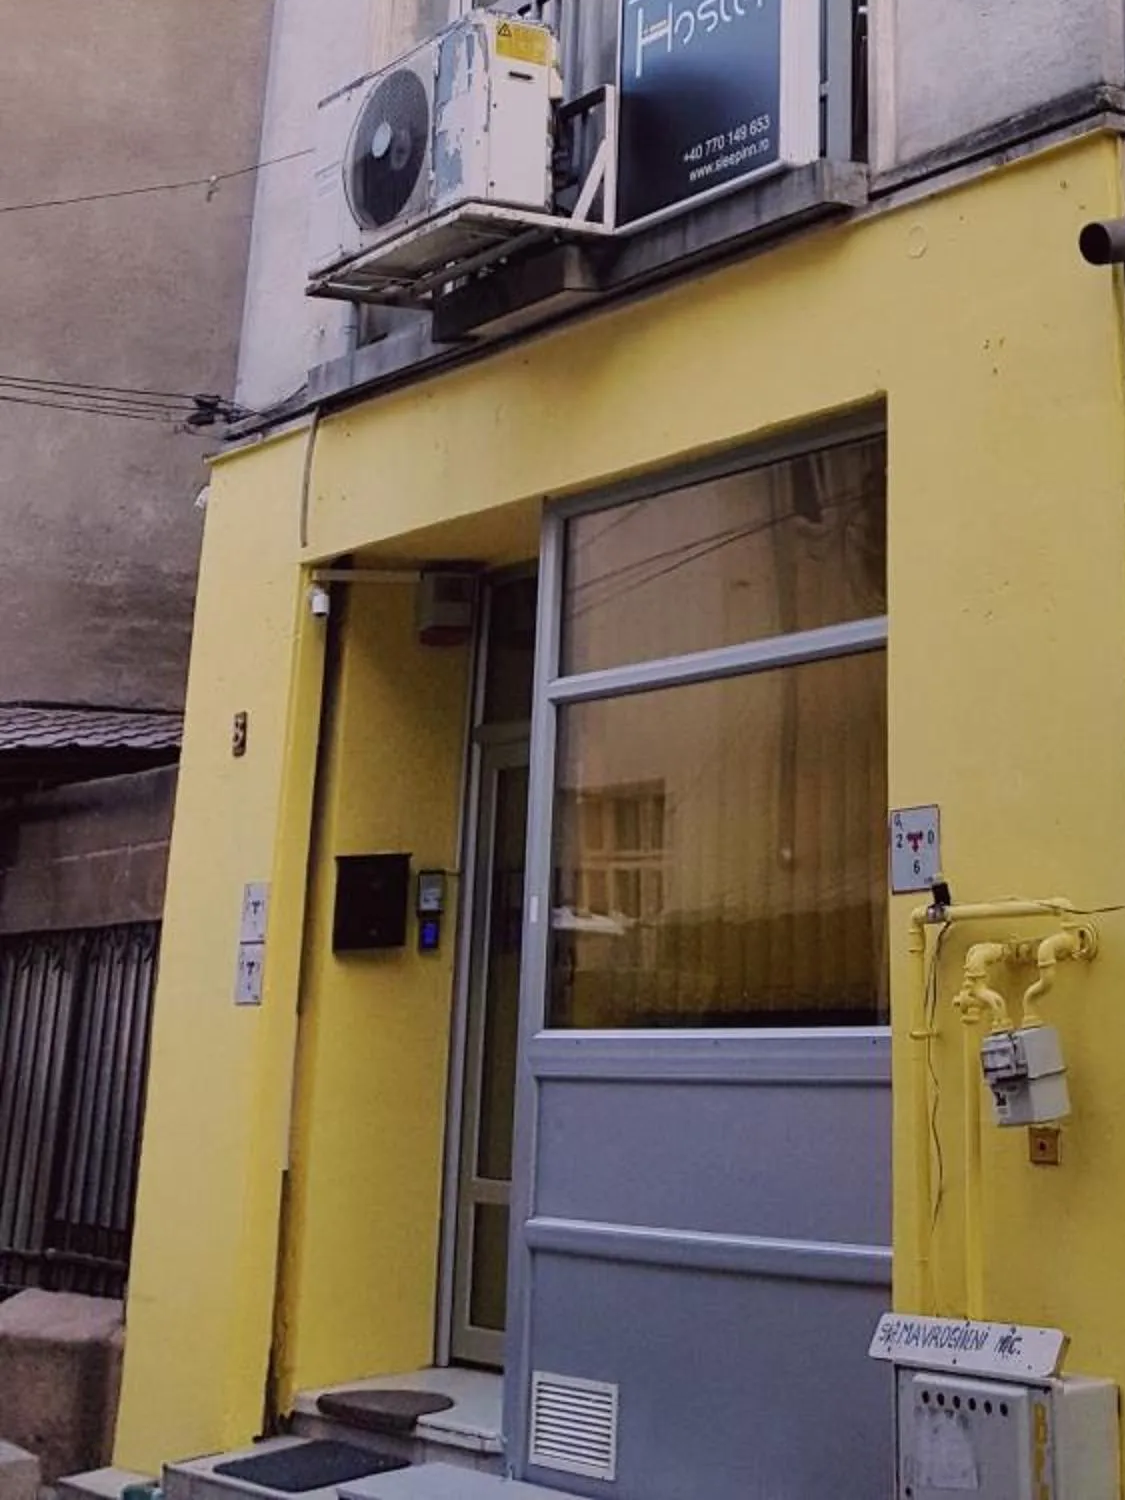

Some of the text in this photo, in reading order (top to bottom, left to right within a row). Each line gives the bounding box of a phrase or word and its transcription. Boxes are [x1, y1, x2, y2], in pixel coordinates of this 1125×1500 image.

[683, 114, 770, 162] +40 770 149 653
[689, 138, 770, 181] www.sleepinn.ro
